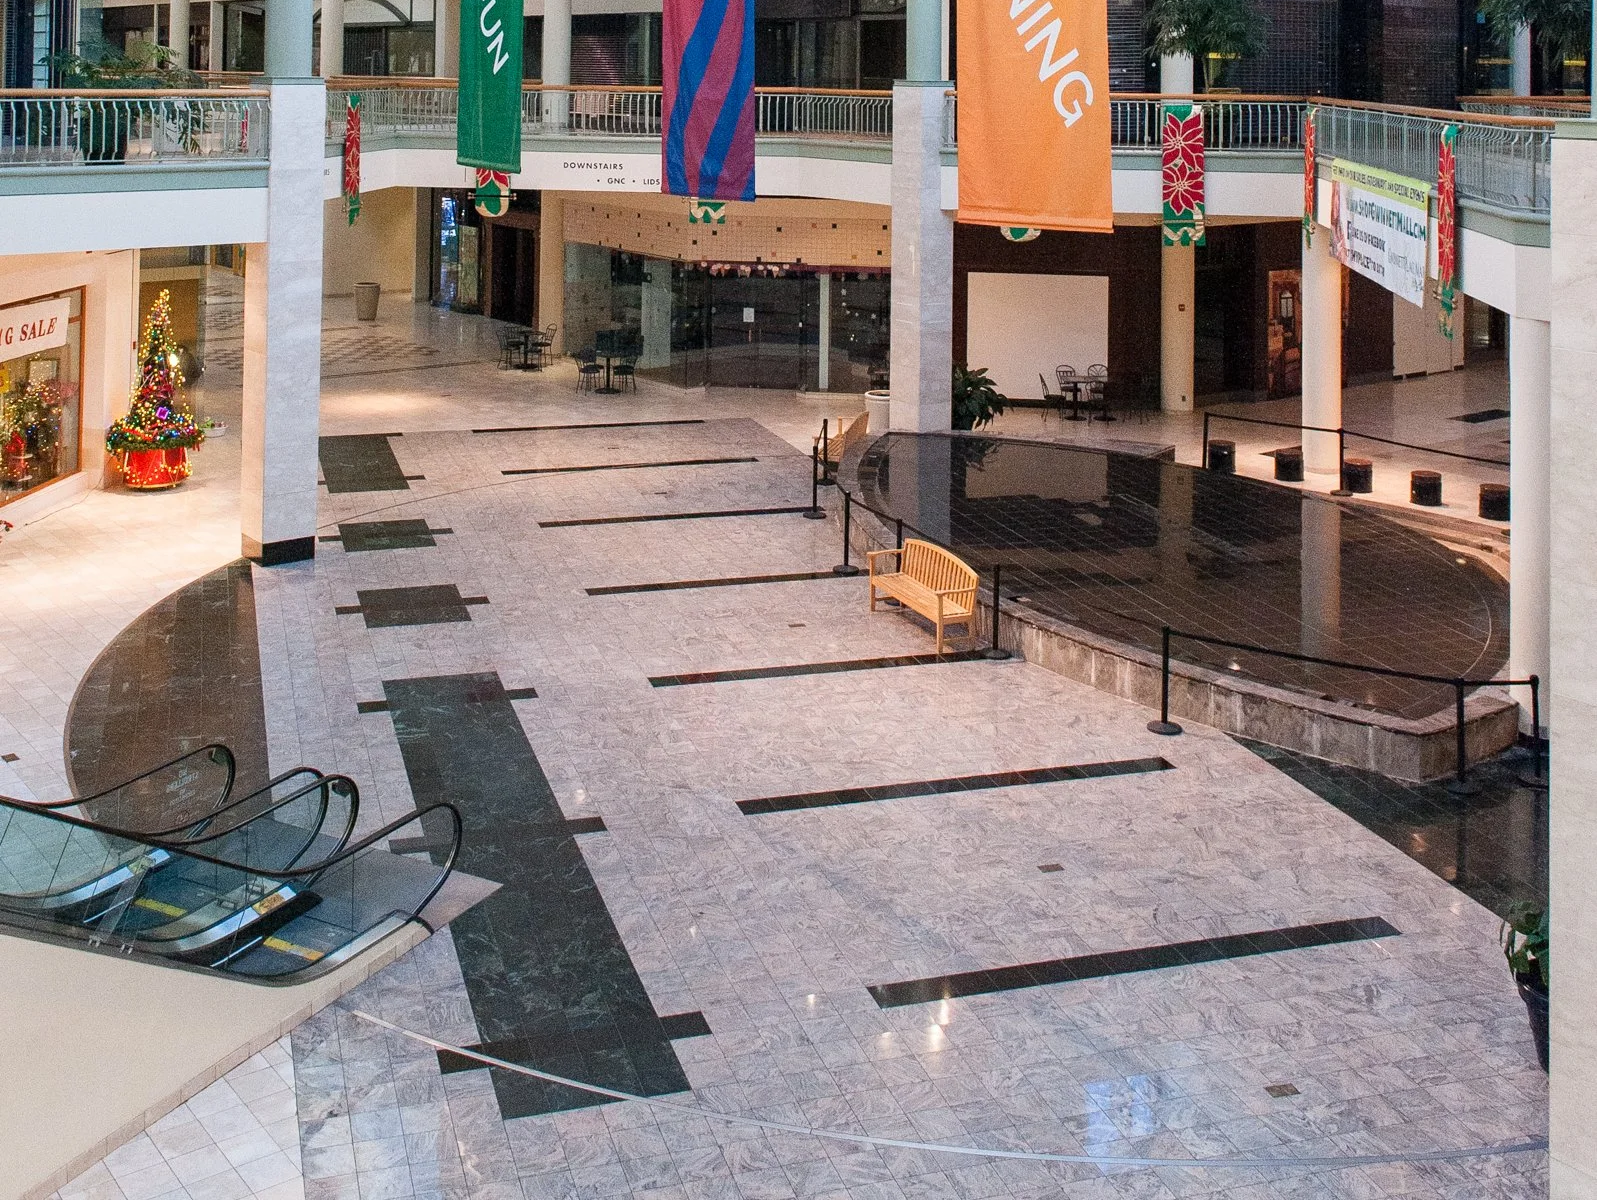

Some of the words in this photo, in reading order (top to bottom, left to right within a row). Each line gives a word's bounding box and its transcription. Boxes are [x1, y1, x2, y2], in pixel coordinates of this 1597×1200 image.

[563, 162, 624, 170] DOWNSTAIRS
[607, 177, 626, 185] GNC
[643, 178, 661, 186] LIDS
[20, 317, 57, 341] SALE
